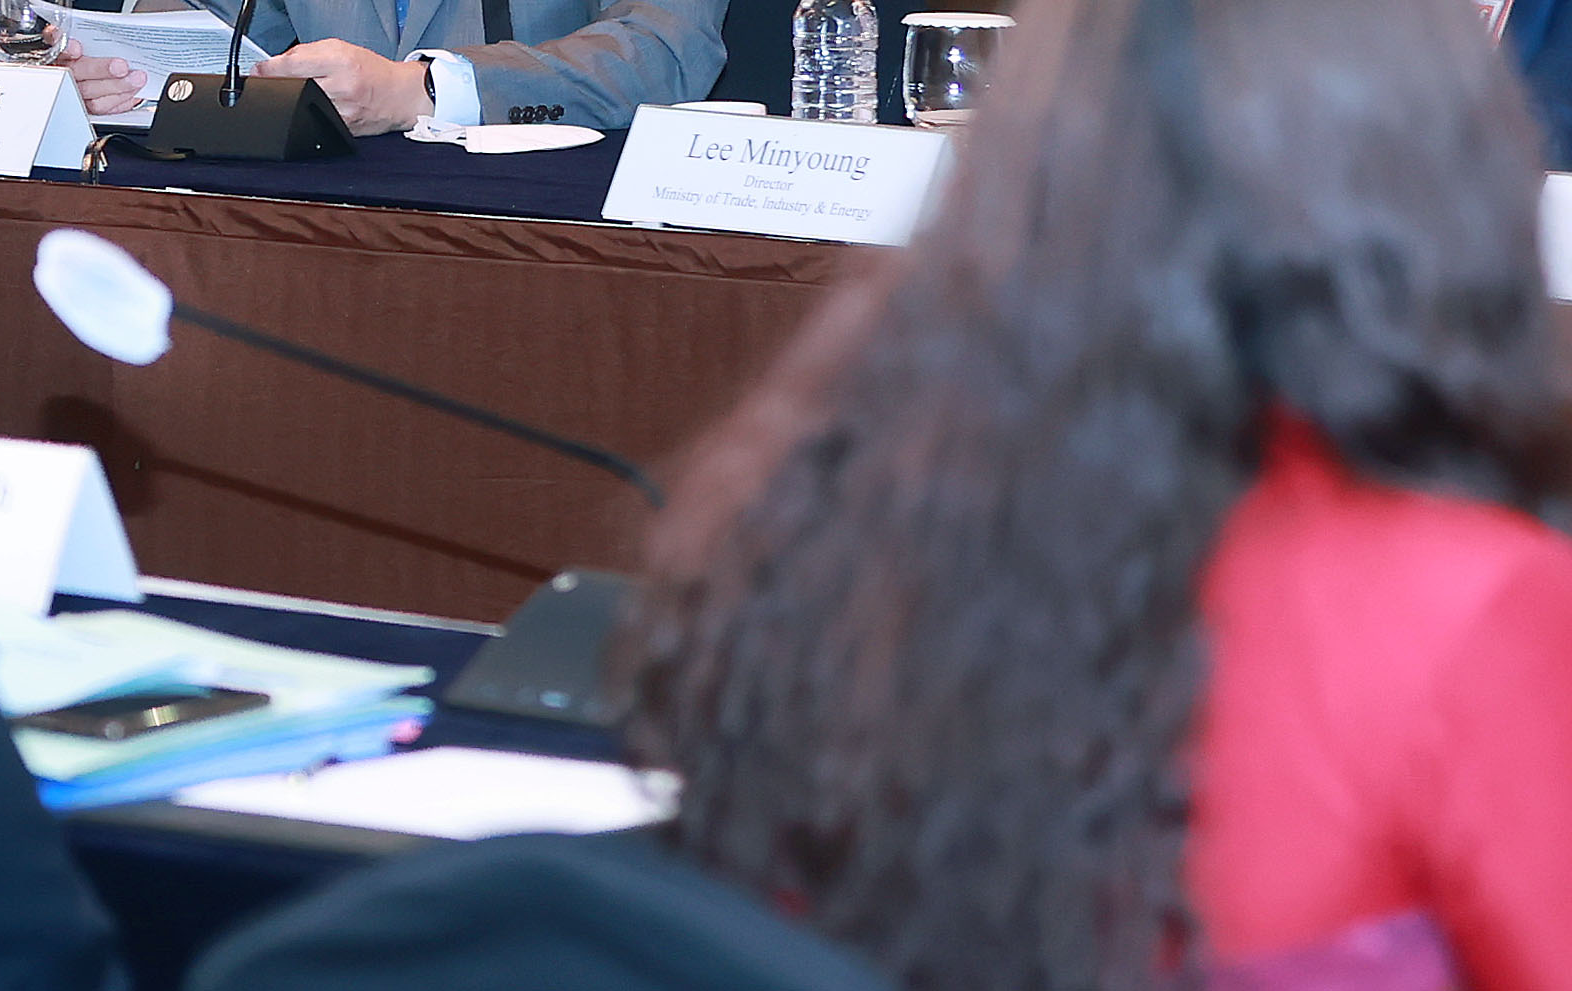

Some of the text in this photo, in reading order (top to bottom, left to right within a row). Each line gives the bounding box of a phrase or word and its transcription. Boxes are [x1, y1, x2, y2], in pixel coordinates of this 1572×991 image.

[686, 133, 870, 181] Lee Minyoung
[743, 174, 794, 191] Director
[652, 186, 702, 205] Ministry
[705, 192, 721, 204] of
[762, 196, 811, 216] Industry
[813, 201, 826, 214] &
[829, 201, 872, 221] Energy
